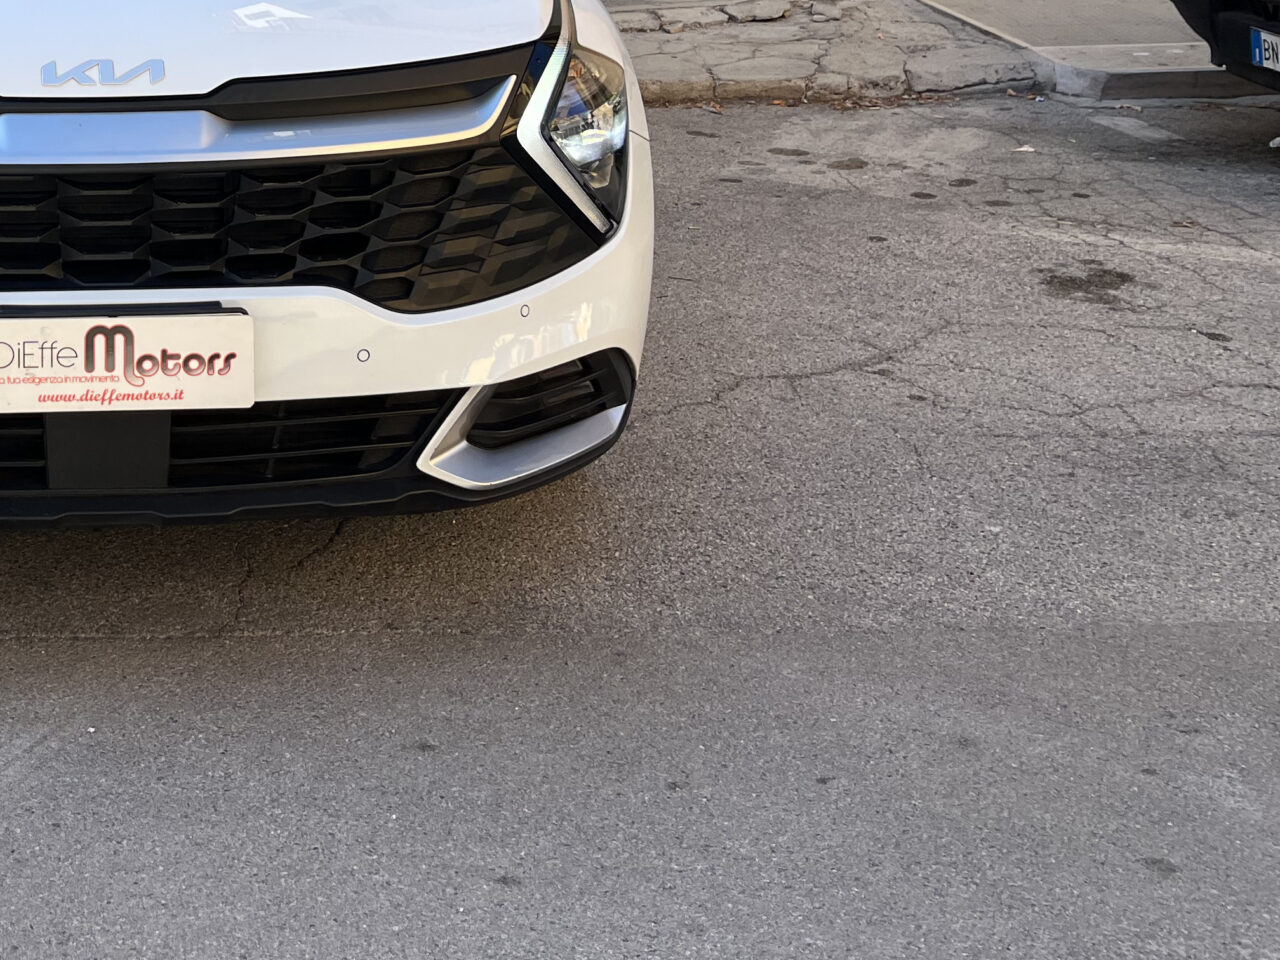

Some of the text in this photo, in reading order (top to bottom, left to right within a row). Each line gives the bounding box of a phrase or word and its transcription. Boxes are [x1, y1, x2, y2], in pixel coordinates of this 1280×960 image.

[1262, 38, 1279, 65] BN
[84, 324, 237, 388] Motors
[71, 374, 120, 383] movimento
[38, 389, 185, 406] www.dieffemotors.it
